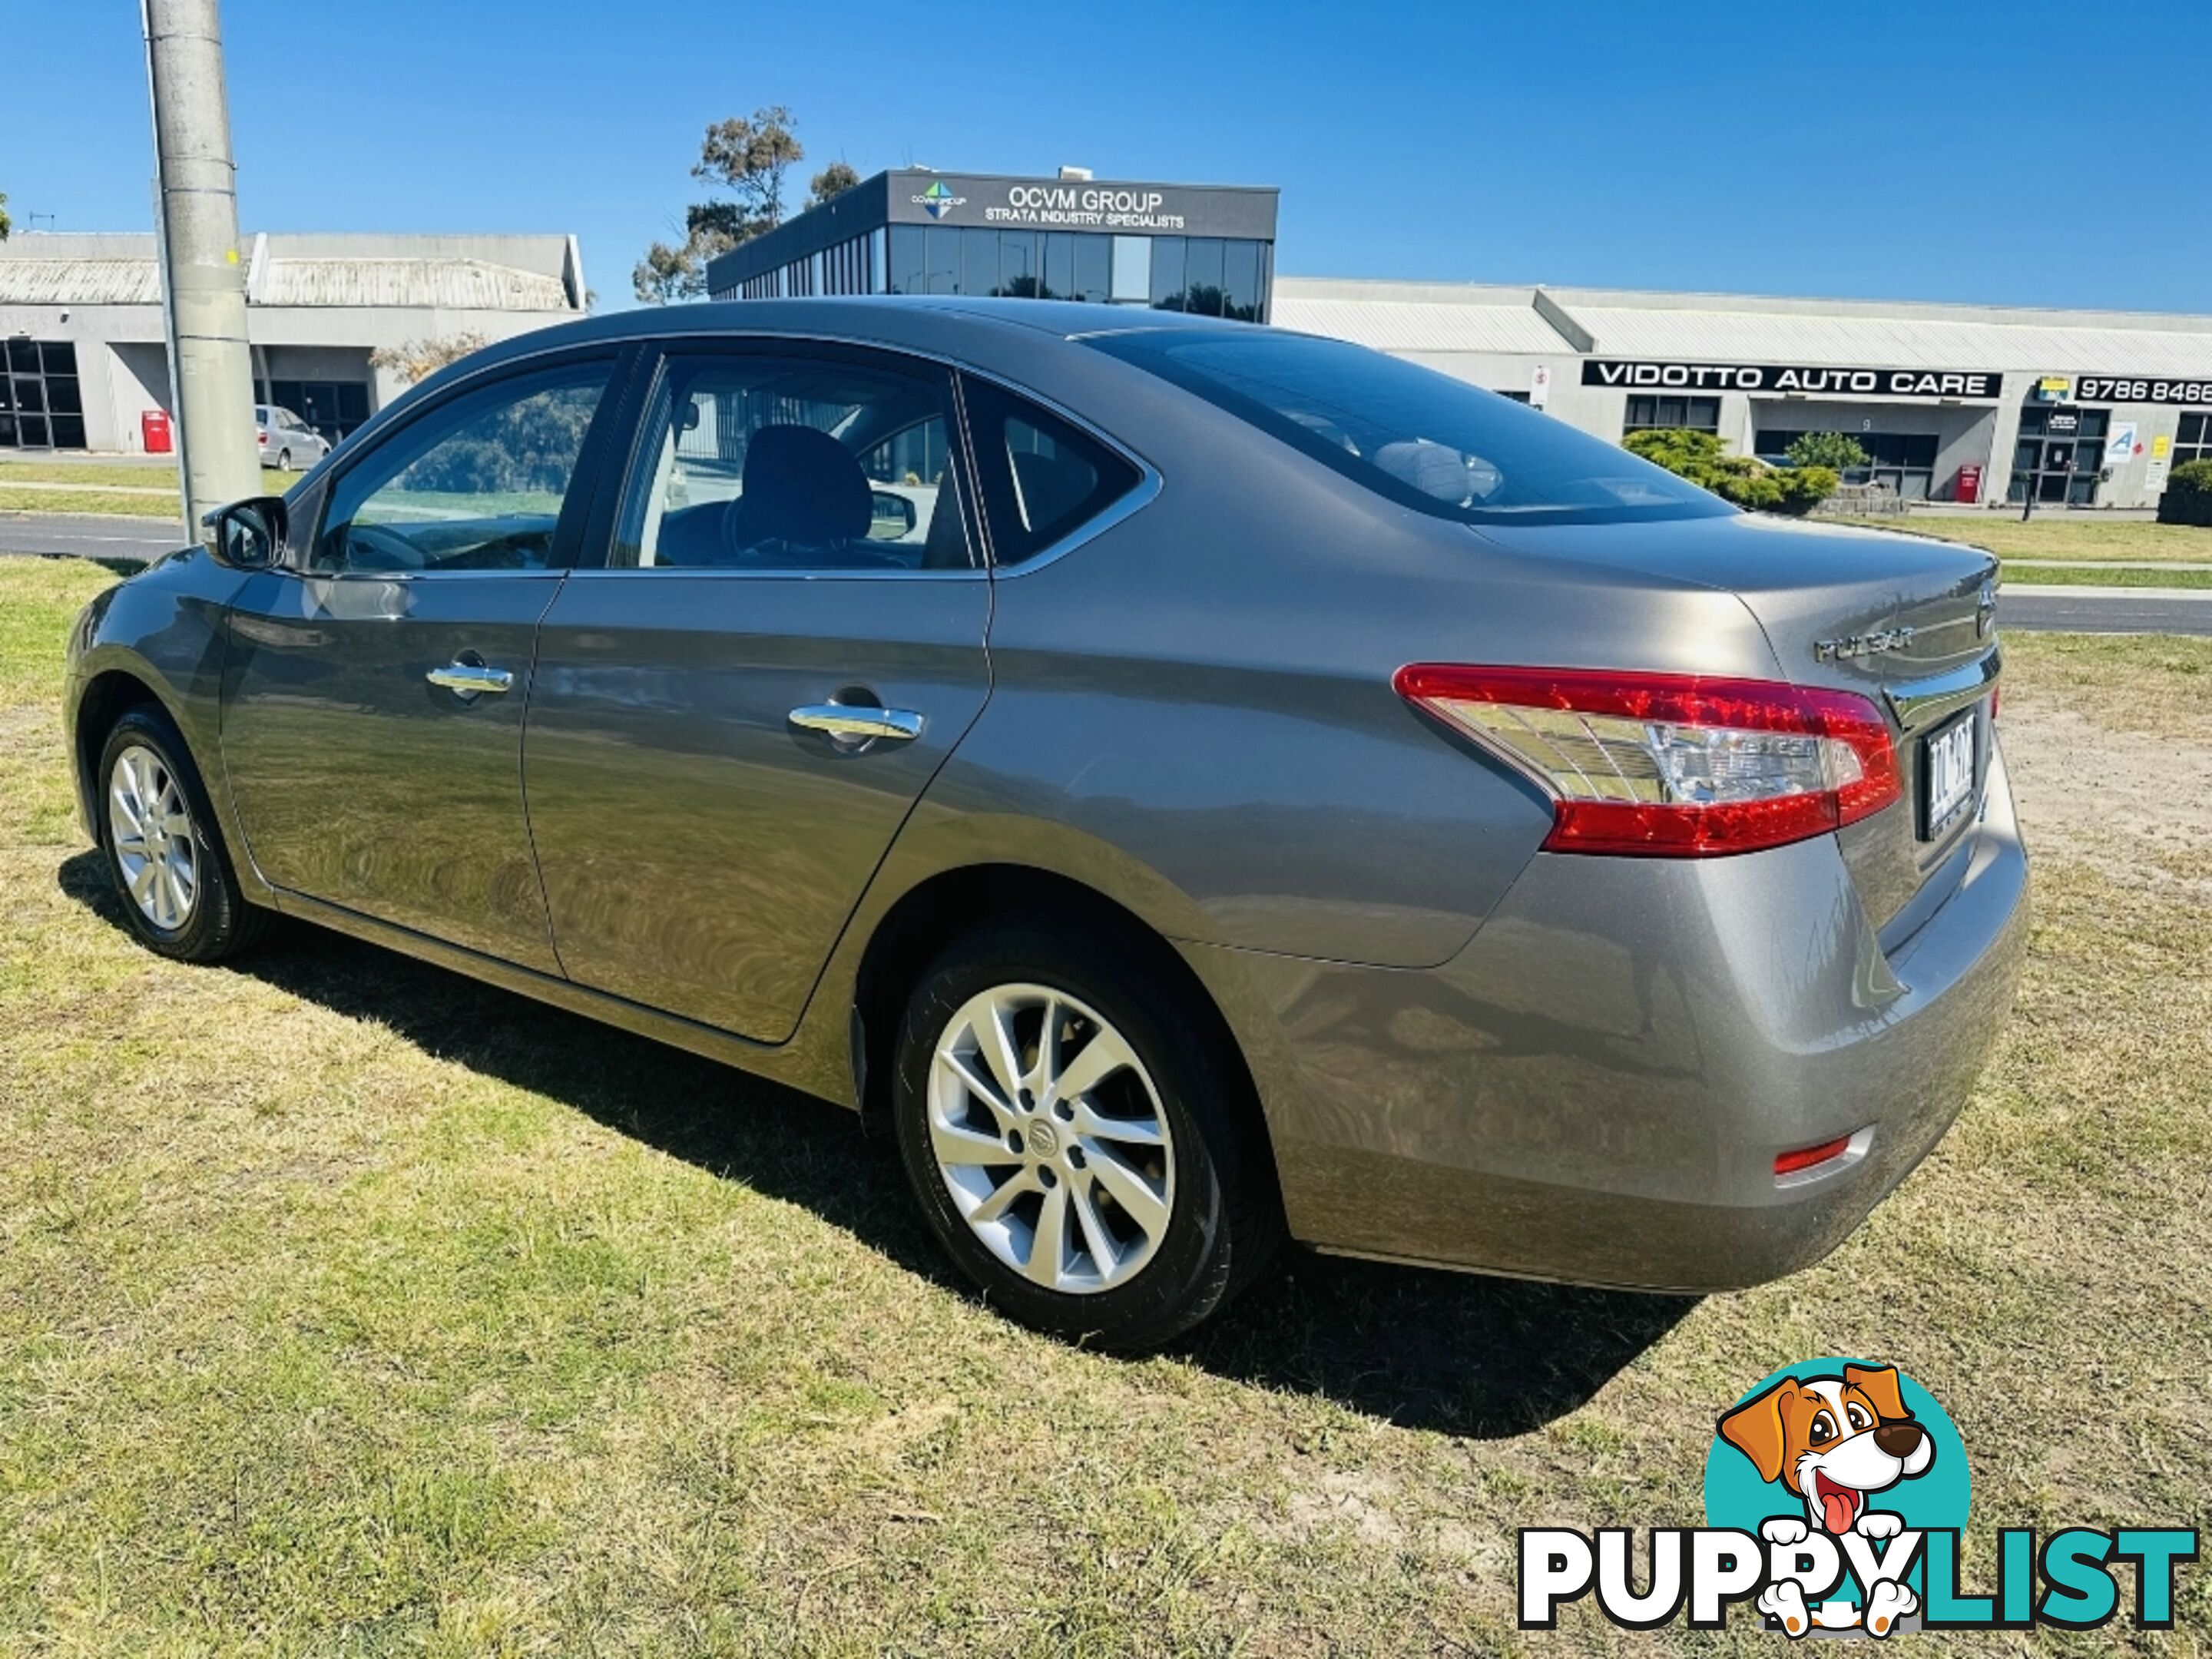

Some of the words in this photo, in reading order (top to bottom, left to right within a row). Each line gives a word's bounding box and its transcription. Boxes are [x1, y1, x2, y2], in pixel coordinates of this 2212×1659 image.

[1008, 187, 1076, 210] OCVM
[1081, 190, 1163, 214] GROUP
[985, 207, 1038, 222] STRATA
[1041, 210, 1103, 225] INDUSTRY
[1106, 213, 1184, 229] SPECIALISTS
[1598, 363, 1763, 388] VIDOTTO
[1774, 369, 1877, 391] AUTO
[1890, 373, 1988, 395] CARE
[2081, 379, 2148, 399] 9786
[1863, 419, 1871, 431] 9
[1813, 628, 1913, 663] PULSAR
